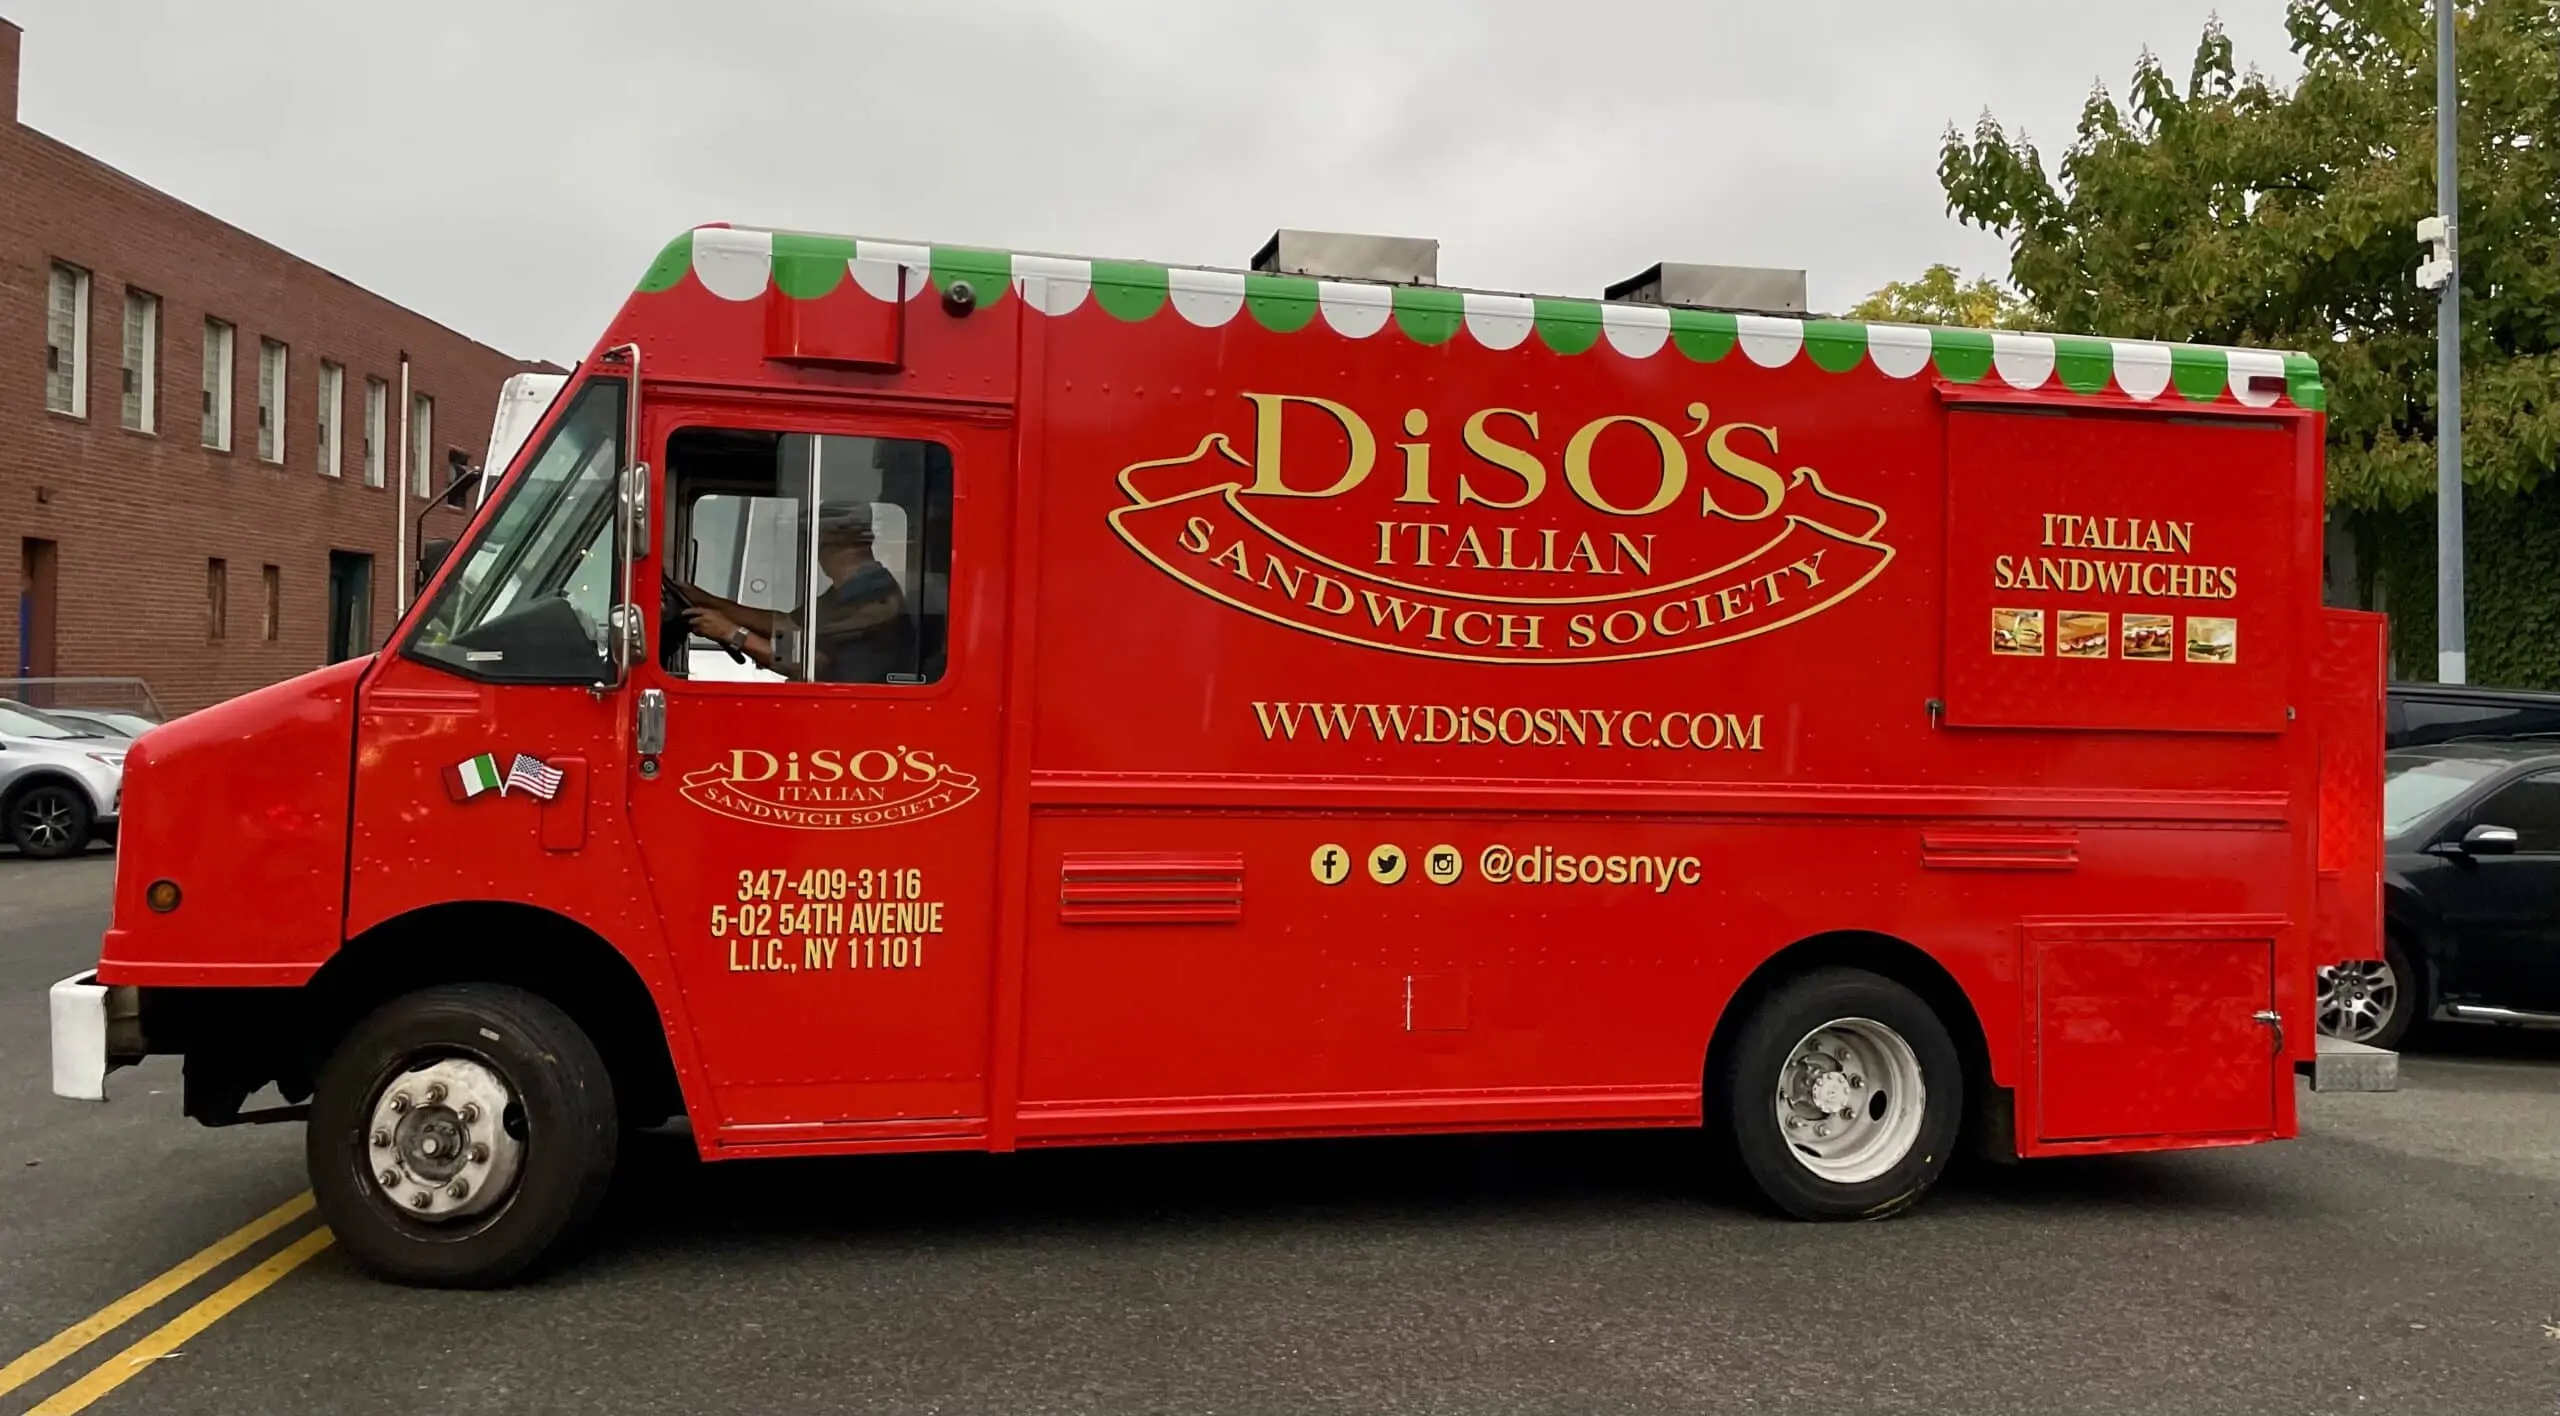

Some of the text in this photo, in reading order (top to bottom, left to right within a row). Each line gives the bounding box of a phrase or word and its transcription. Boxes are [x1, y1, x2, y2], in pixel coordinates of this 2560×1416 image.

[1240, 392, 1788, 522] DiSO'S
[1374, 520, 1657, 577] ITALIAN
[2041, 512, 2195, 553] ITALIAN
[1177, 516, 1828, 650] SANDWICH SOCIETY
[1993, 555, 2238, 600] SANDWICHES
[728, 745, 938, 784] DiSO'S
[703, 786, 954, 827] SANDWICH SOCIETY
[777, 786, 886, 802] ITALIAN
[736, 869, 922, 902] 347-409-3116
[1480, 844, 1702, 893] @disosnyc
[710, 902, 945, 937] 5-02 54TH AVENUE
[729, 936, 923, 974] L.I.C., NY 11101
